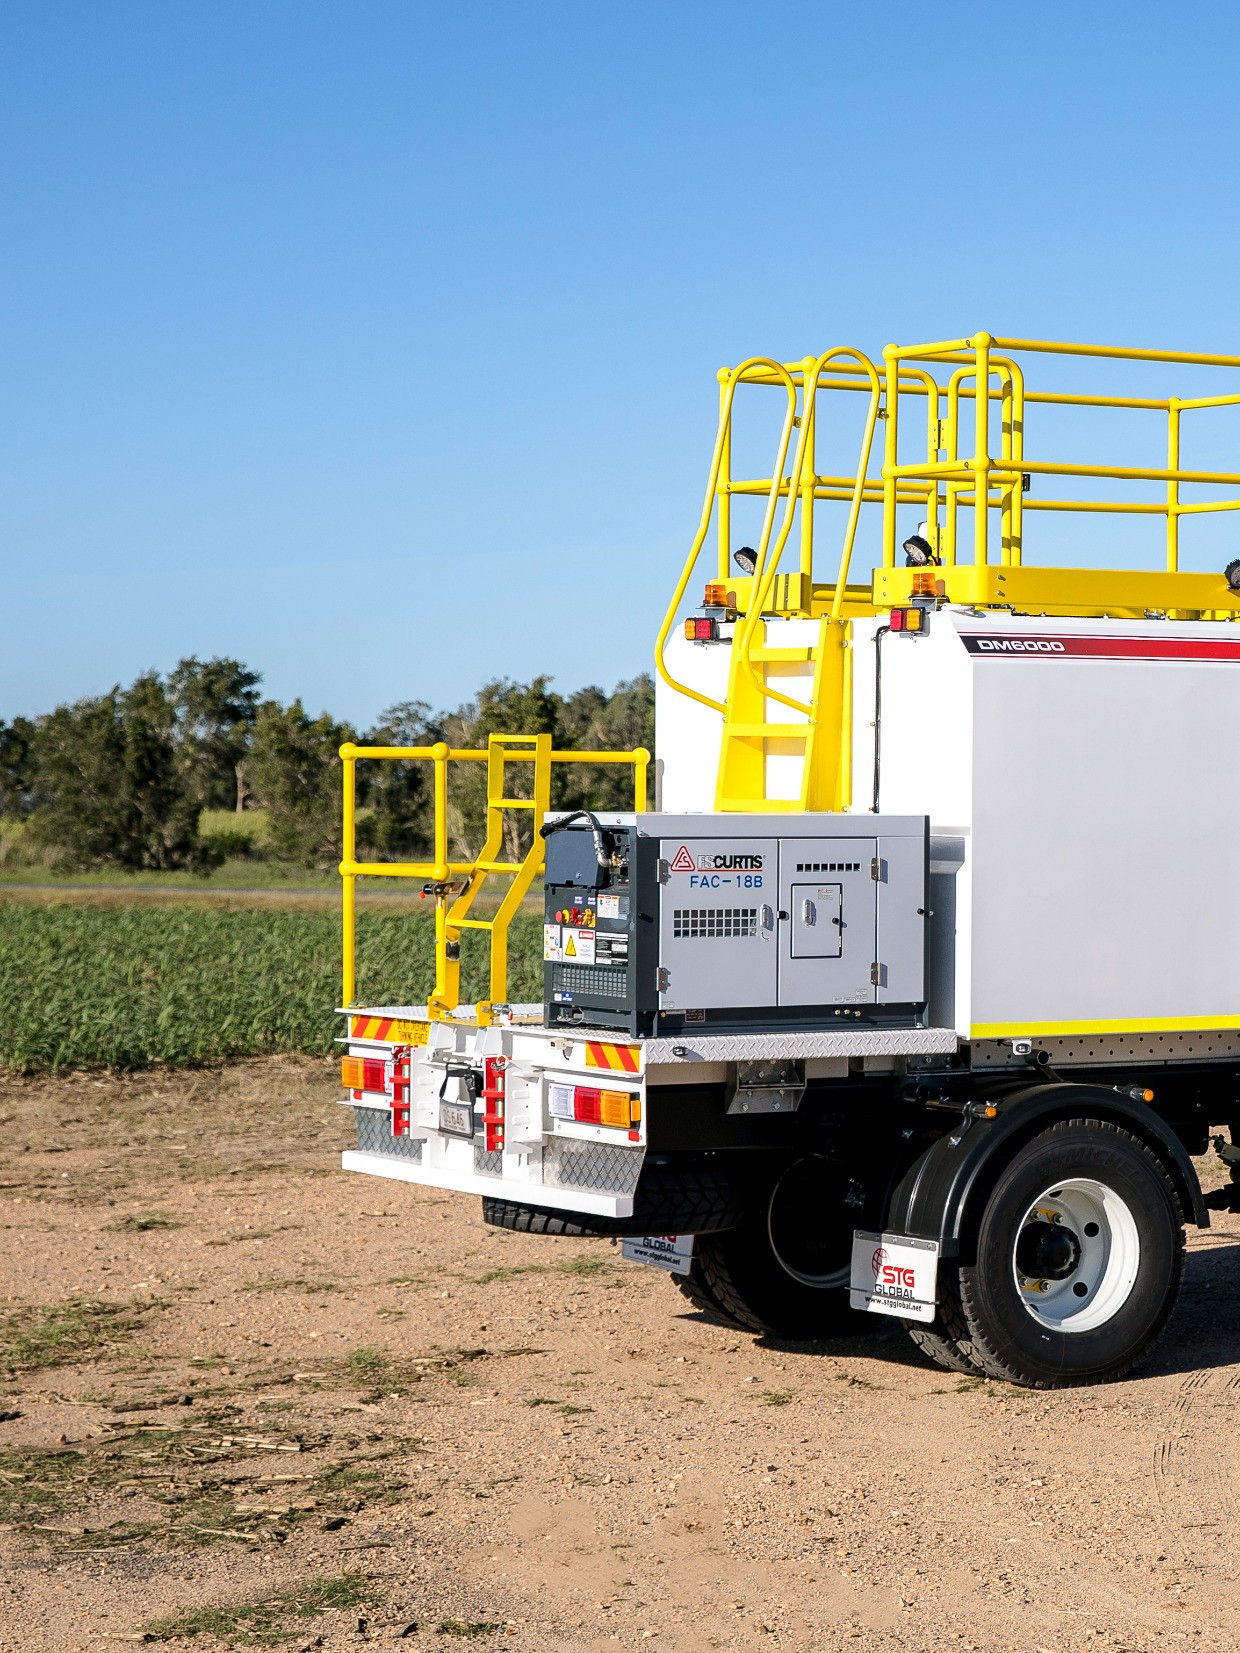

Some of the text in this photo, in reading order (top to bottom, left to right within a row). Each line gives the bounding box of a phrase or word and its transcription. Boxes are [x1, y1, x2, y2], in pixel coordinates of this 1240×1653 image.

[976, 639, 1066, 652] DM6000
[697, 854, 763, 869] FSCURTIS
[690, 874, 763, 888] FAC-18B
[642, 1237, 677, 1253] GLOBAL
[882, 1265, 915, 1288] STG
[874, 1283, 916, 1299] GLOBAL
[864, 1296, 922, 1312] www.stgglobal.net
